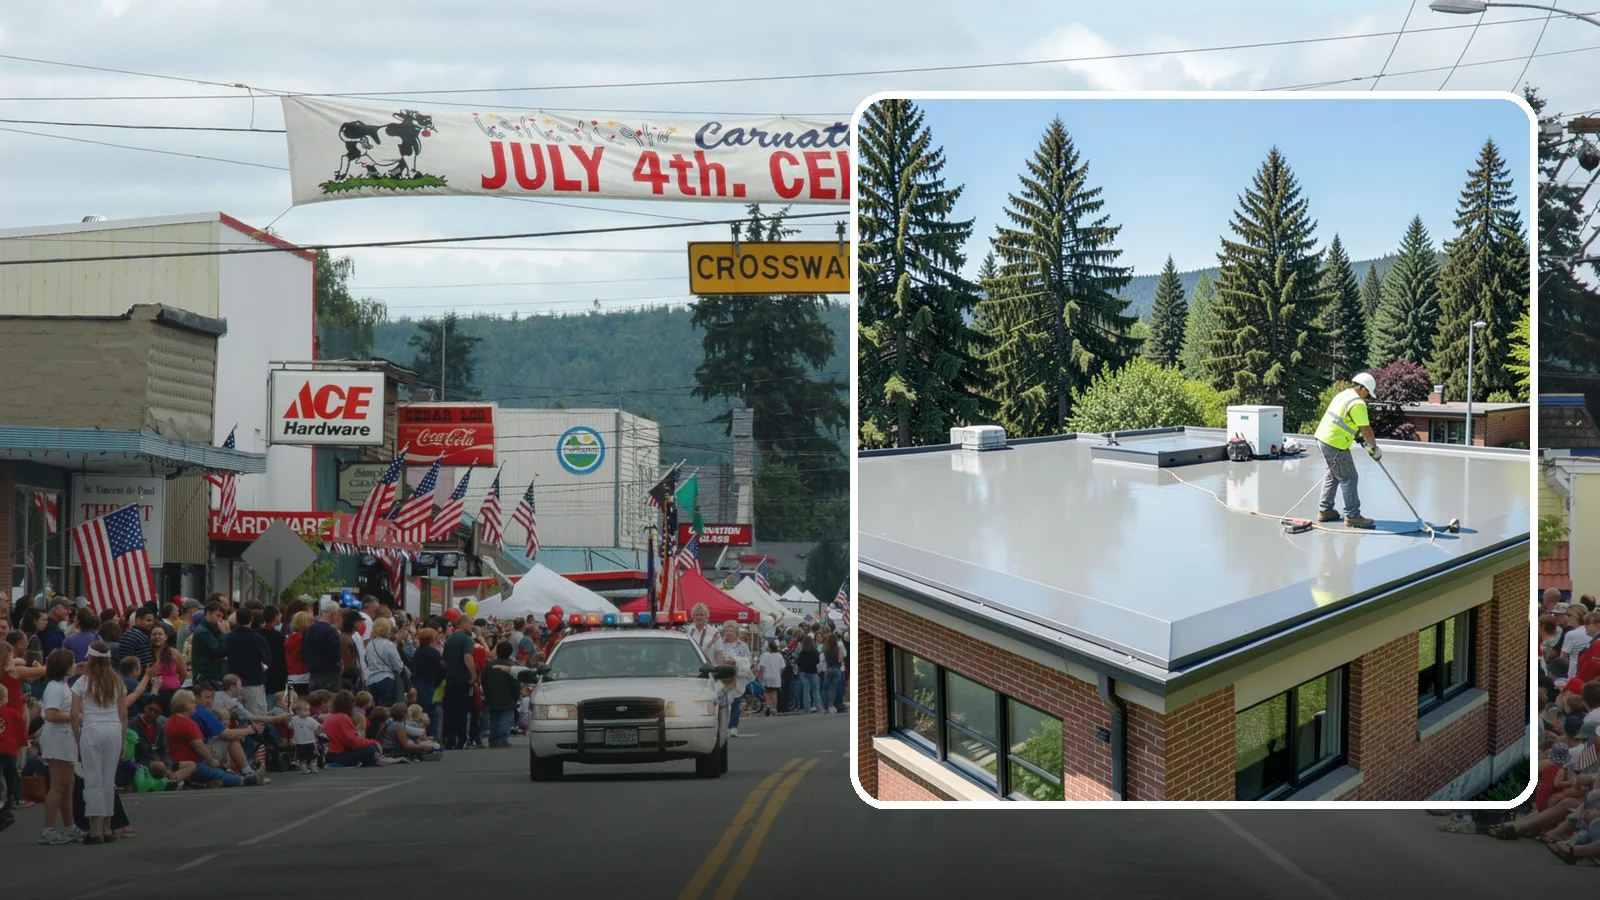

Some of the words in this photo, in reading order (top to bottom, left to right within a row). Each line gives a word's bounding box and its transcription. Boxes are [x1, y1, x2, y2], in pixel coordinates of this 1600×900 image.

[695, 121, 850, 149] Carnat
[481, 140, 605, 193] JULY
[632, 150, 746, 197] 4th.
[697, 254, 850, 280] CROSSWA
[282, 380, 373, 420] ACE
[405, 409, 453, 422] CEDAR
[461, 409, 485, 421] LOG
[283, 421, 371, 436] Hardware
[416, 428, 477, 447] Coca-Cola
[353, 467, 385, 480] Simpl
[83, 485, 93, 494] St.
[95, 485, 124, 494] Vincent
[126, 486, 135, 494] de
[137, 486, 155, 495] Paul
[688, 526, 741, 535] CRNATION
[699, 535, 730, 543] GLASS
